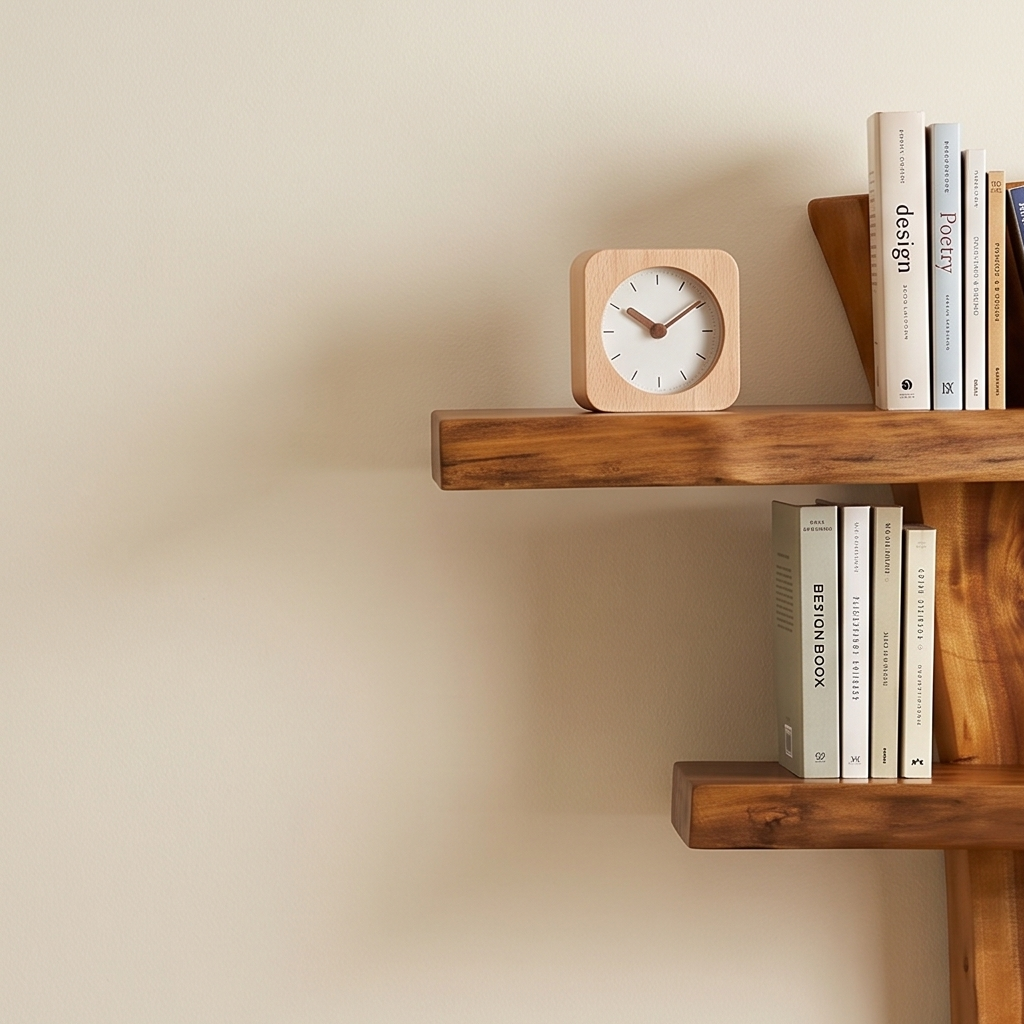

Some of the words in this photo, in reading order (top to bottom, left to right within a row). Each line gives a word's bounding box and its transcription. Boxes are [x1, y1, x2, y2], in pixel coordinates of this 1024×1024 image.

[891, 204, 915, 273] design
[935, 212, 957, 274] Poetry
[814, 644, 826, 688] BOOX
